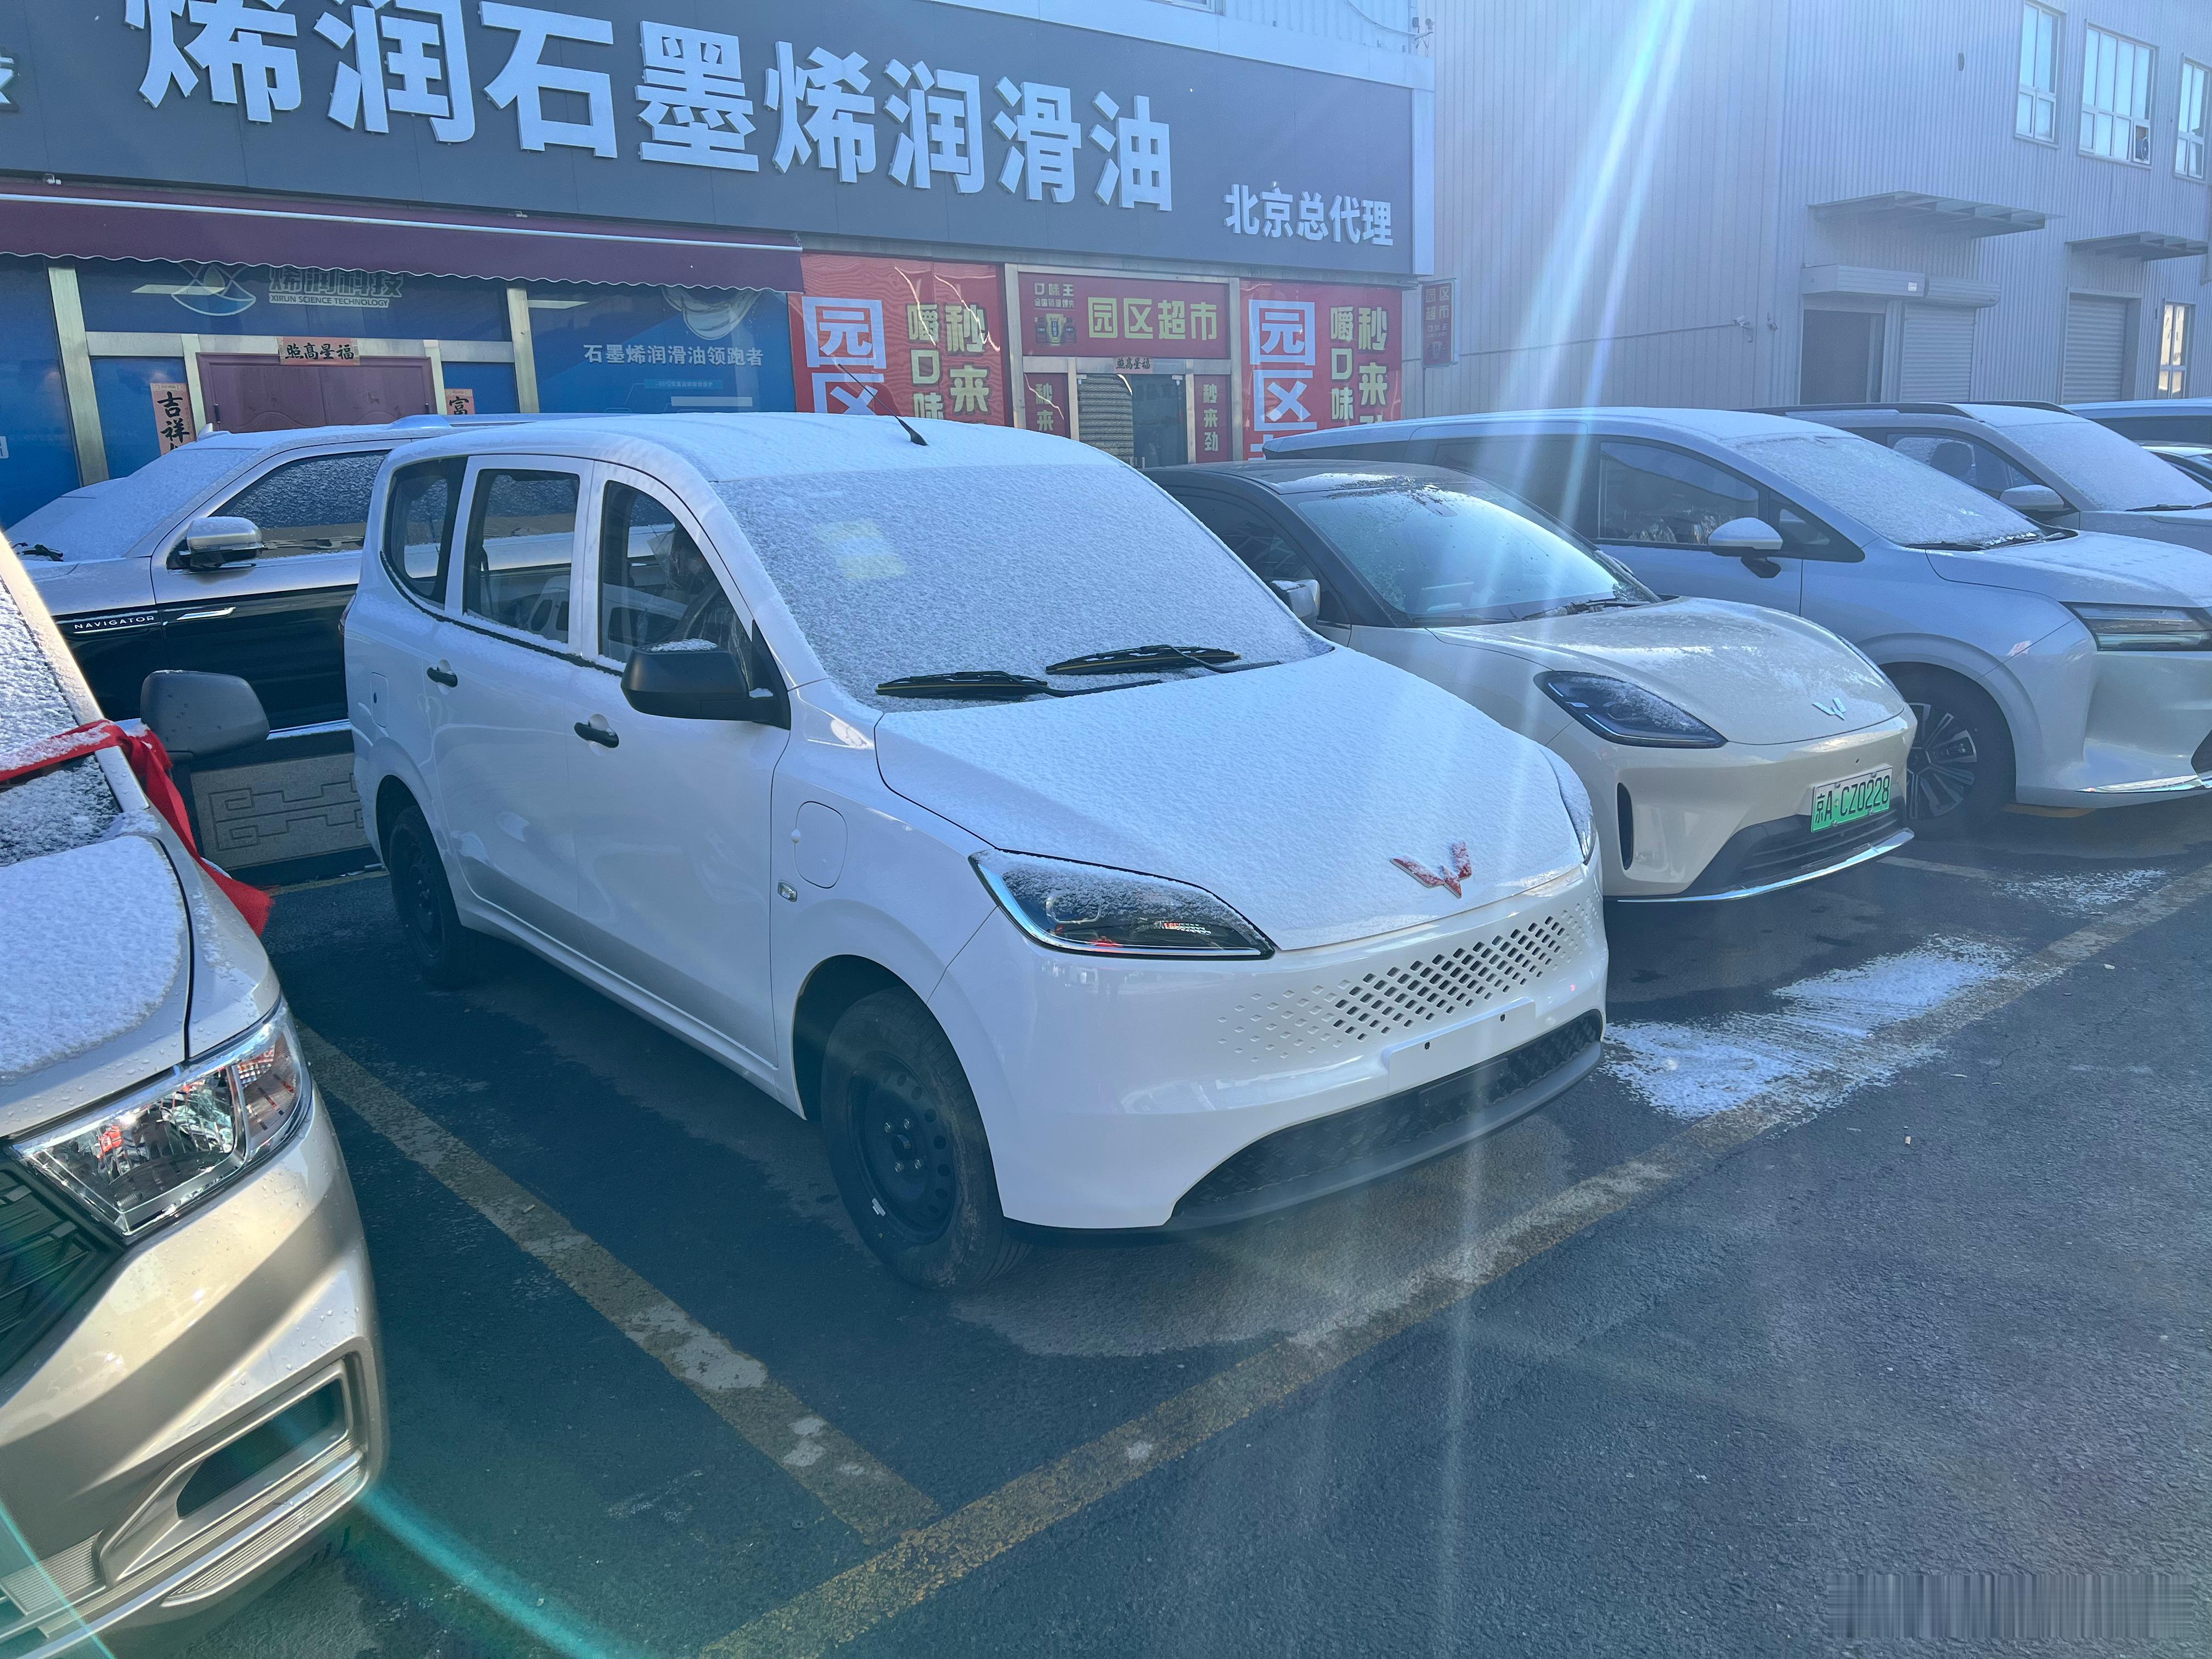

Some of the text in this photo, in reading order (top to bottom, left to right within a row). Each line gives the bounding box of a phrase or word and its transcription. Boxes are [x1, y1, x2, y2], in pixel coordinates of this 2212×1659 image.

[125, 0, 1172, 212] 烯润石墨烯润滑油
[1224, 184, 1393, 246] 北京总代理
[270, 294, 388, 307] XIRUN SCIENCE TECHNOLOGY
[1034, 283, 1074, 296] 口味王
[1088, 297, 1217, 341] 园区超市
[1425, 305, 1449, 320] 超市
[1426, 286, 1451, 302] 园区
[583, 344, 764, 366] 石墨烯润滑油领跑者
[802, 296, 887, 416] 园区
[907, 304, 944, 420] 嚼口味
[1248, 299, 1317, 460] 园区
[1330, 307, 1354, 420] 嚼口味
[1358, 307, 1387, 424] 秒来
[157, 391, 190, 451] 吉祥
[1035, 383, 1053, 431] 秒来
[1203, 384, 1218, 452] 秒来劲
[74, 616, 154, 629] NAVIGATOR
